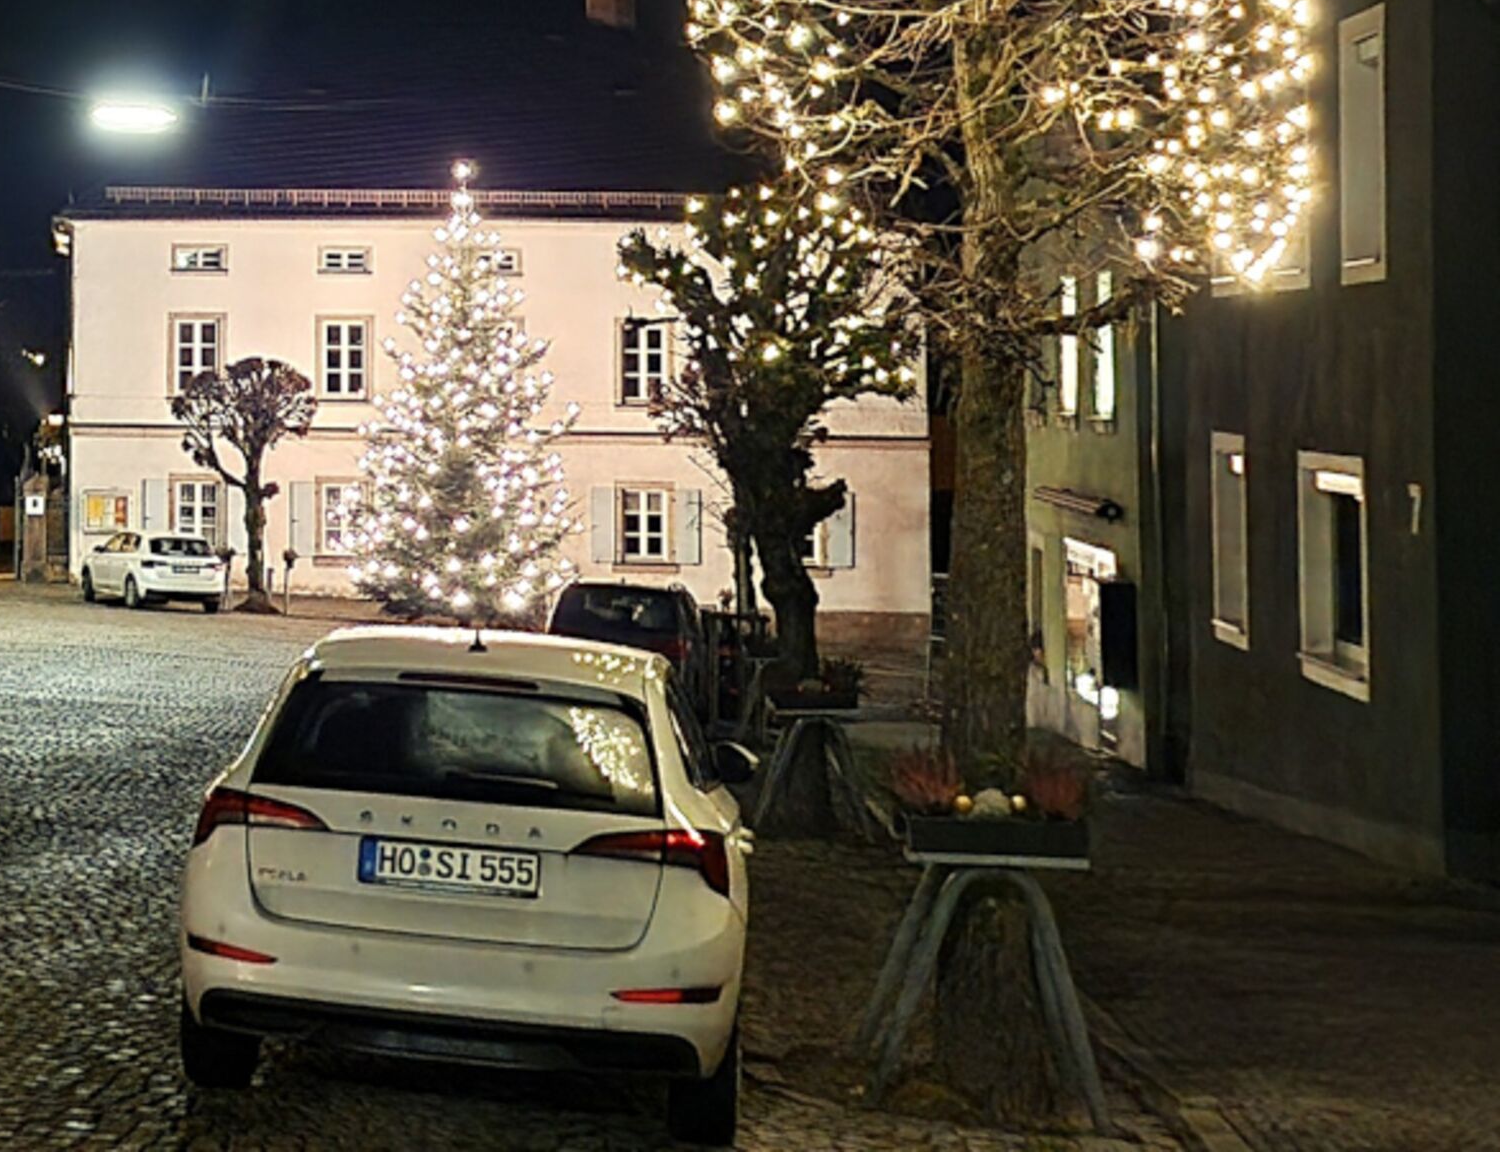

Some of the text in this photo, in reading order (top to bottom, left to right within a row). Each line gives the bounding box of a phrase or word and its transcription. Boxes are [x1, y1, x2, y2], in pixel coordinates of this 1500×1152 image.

[378, 844, 534, 886] HO SI 555
